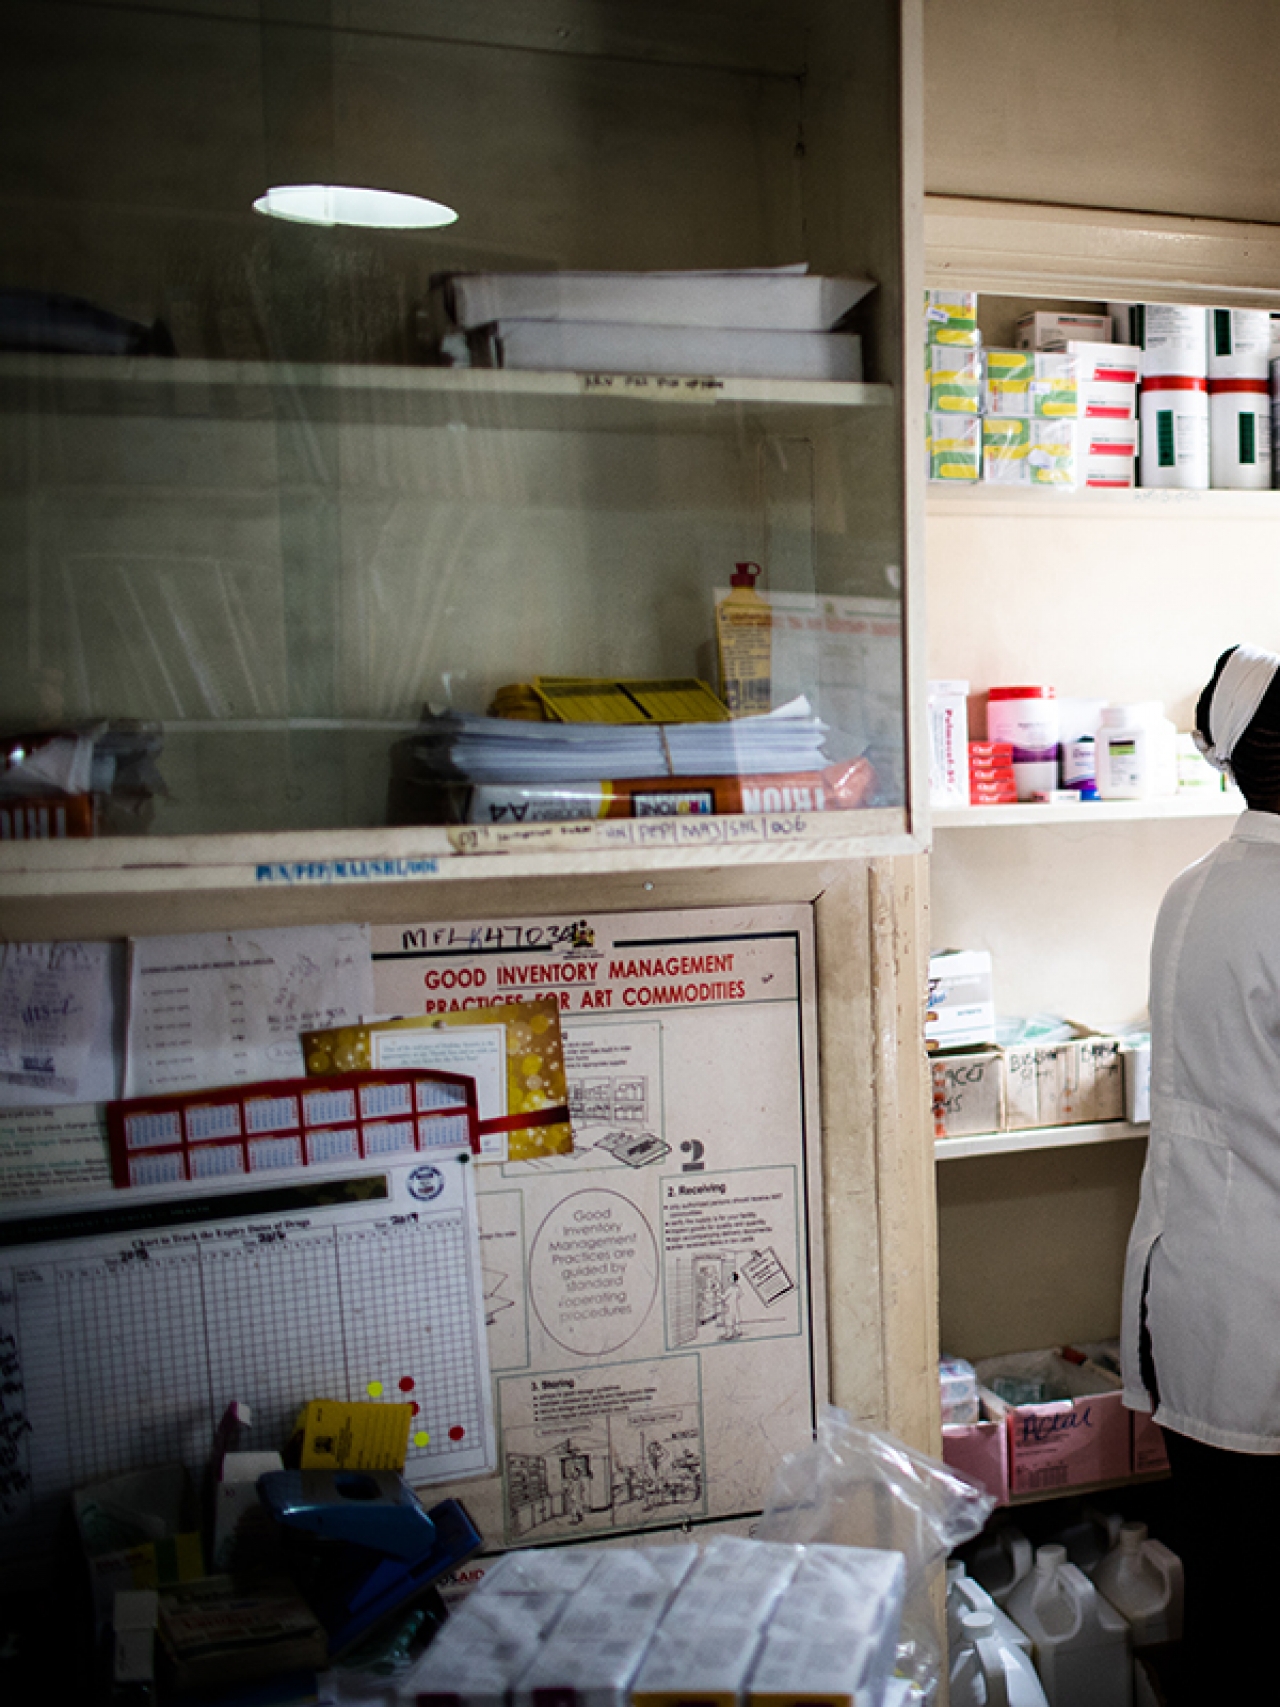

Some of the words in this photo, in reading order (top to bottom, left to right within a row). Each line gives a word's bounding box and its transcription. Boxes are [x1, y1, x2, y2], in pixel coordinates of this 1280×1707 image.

[424, 969, 486, 990] GOOD
[496, 962, 598, 986] INVENTORY
[609, 954, 735, 979] MANAGEMENT
[581, 988, 612, 1008] ART
[623, 981, 746, 1006] COMMODITIES
[678, 1182, 726, 1197] Receiving
[573, 1208, 612, 1222] Good
[562, 1222, 622, 1237] Inventory
[548, 1234, 636, 1252] Management
[551, 1250, 611, 1265] Practices
[613, 1248, 635, 1260] are
[561, 1264, 604, 1280] guided
[606, 1262, 627, 1276] by
[566, 1276, 624, 1292] standard
[560, 1304, 632, 1323] procedures
